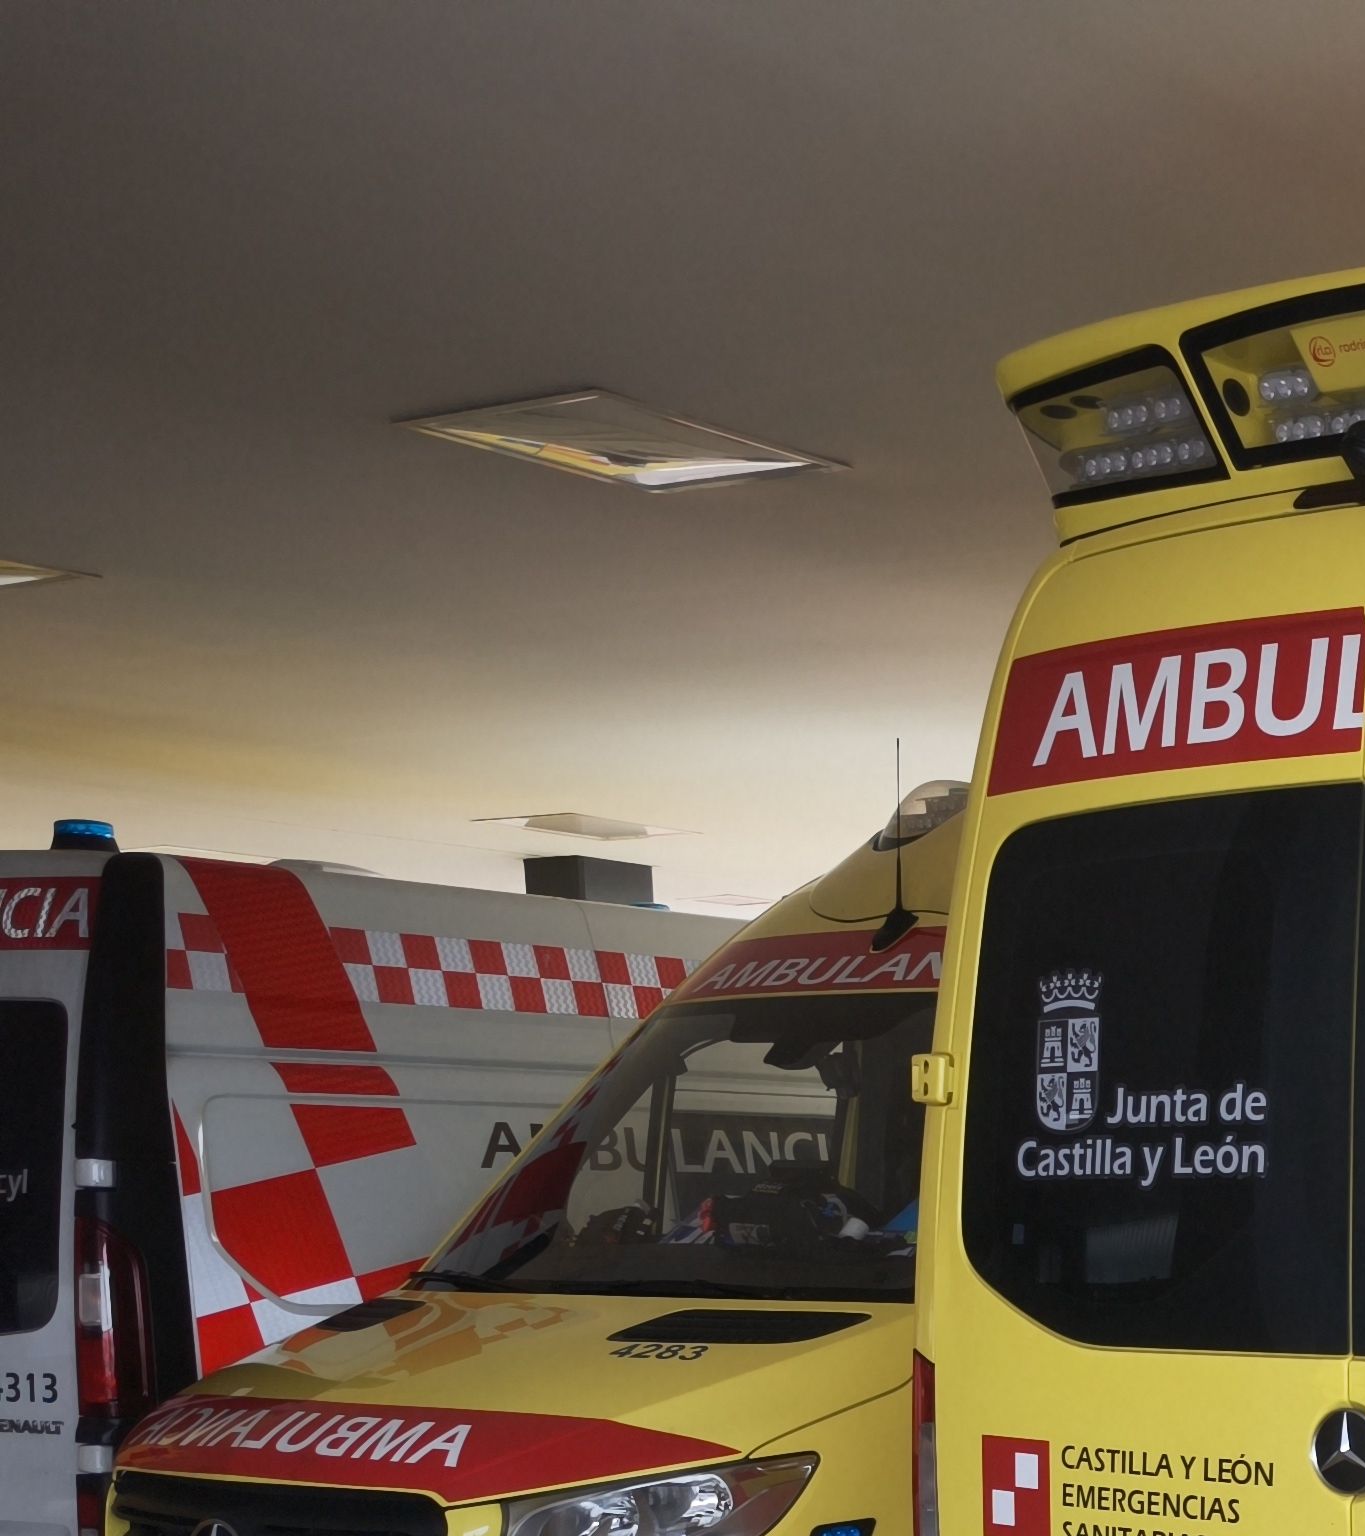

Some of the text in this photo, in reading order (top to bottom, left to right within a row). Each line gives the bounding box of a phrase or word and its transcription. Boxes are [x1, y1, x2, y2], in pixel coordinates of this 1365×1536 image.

[0, 888, 88, 938] CIA
[1107, 1083, 1267, 1124] Junta de
[1017, 1135, 1265, 1187] Castilla y León
[609, 1343, 709, 1361] 4283
[1061, 1445, 1275, 1487] CASTILLA Y LEÓN
[1062, 1483, 1240, 1523] EMERGENCIAS
